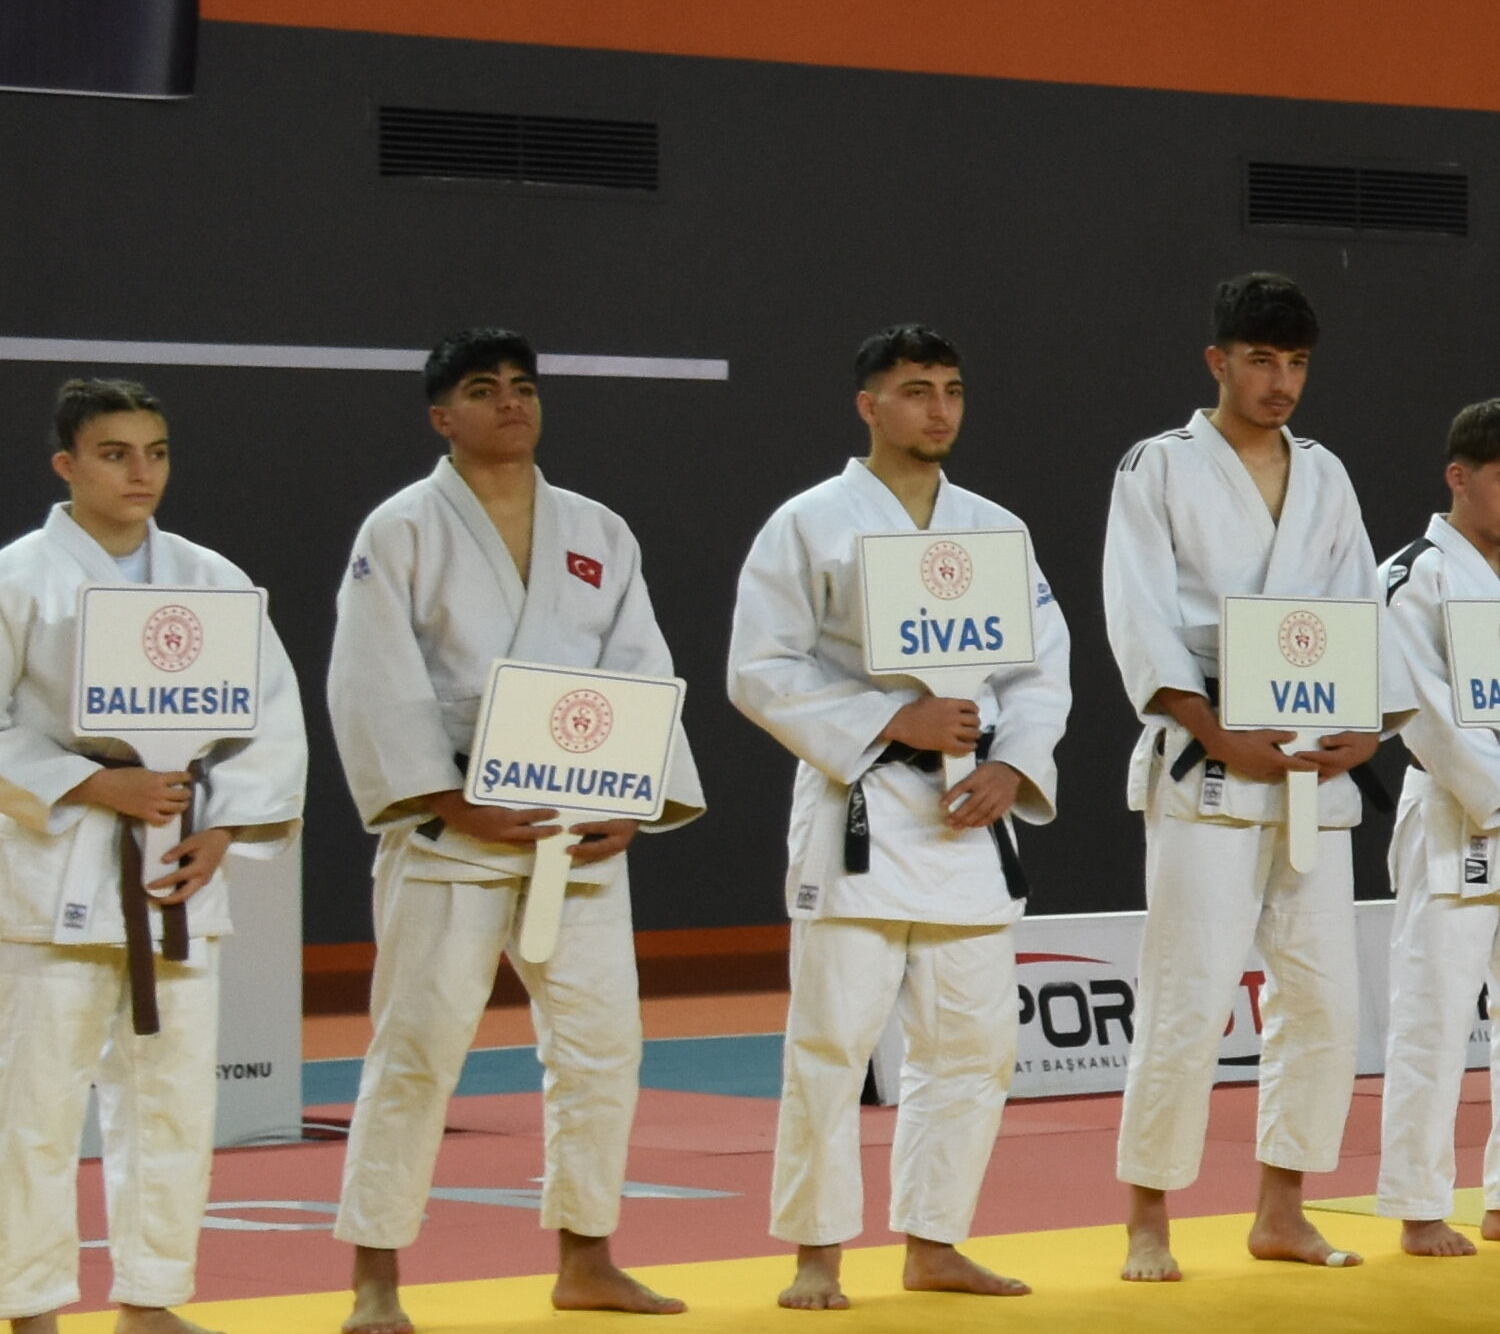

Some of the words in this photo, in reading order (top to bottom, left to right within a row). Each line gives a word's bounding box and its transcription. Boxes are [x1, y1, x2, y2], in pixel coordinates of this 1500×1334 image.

[900, 608, 1003, 655] SİVAS
[87, 681, 249, 714] BALIKESİR
[1271, 681, 1334, 713] VAN
[483, 759, 651, 800] ŞANLIURFA
